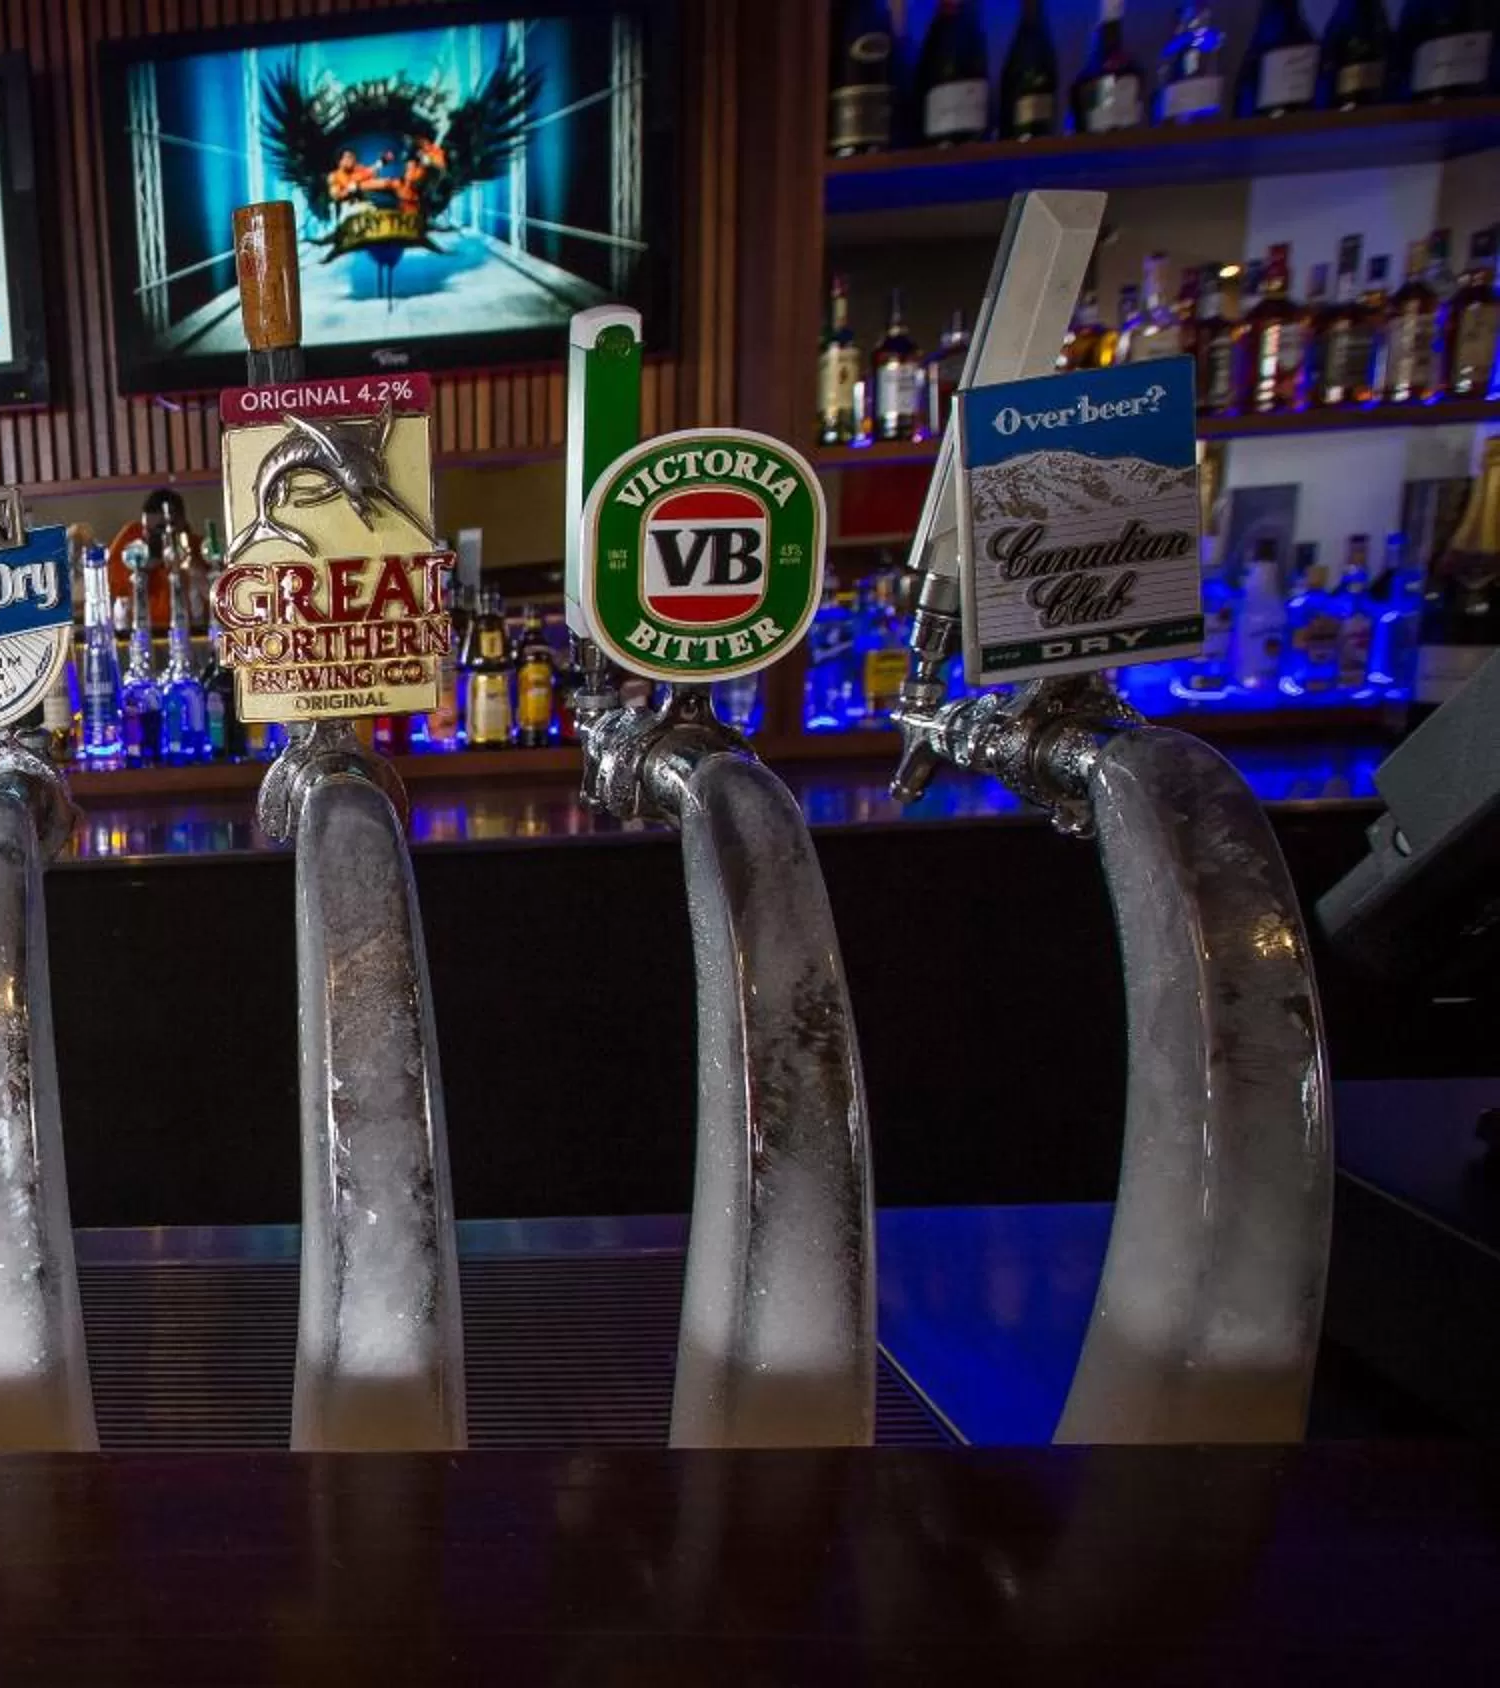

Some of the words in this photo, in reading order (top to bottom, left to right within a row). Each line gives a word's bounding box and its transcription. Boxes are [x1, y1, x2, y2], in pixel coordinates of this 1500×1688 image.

[241, 385, 351, 412] ORIGINAL
[357, 379, 413, 402] 4.2%
[991, 406, 1075, 436] Over
[1075, 384, 1167, 425] beer?
[615, 449, 798, 508] VICTORIA
[648, 526, 763, 587] VB
[985, 519, 1191, 581] Canadian
[212, 551, 457, 630] GREAT
[1025, 568, 1139, 629] Club
[219, 616, 452, 667] NORTHERN
[625, 615, 785, 662] BITTER
[1041, 628, 1150, 659] DRY
[250, 662, 374, 693] BREWING
[296, 690, 388, 711] ORIGINAL
